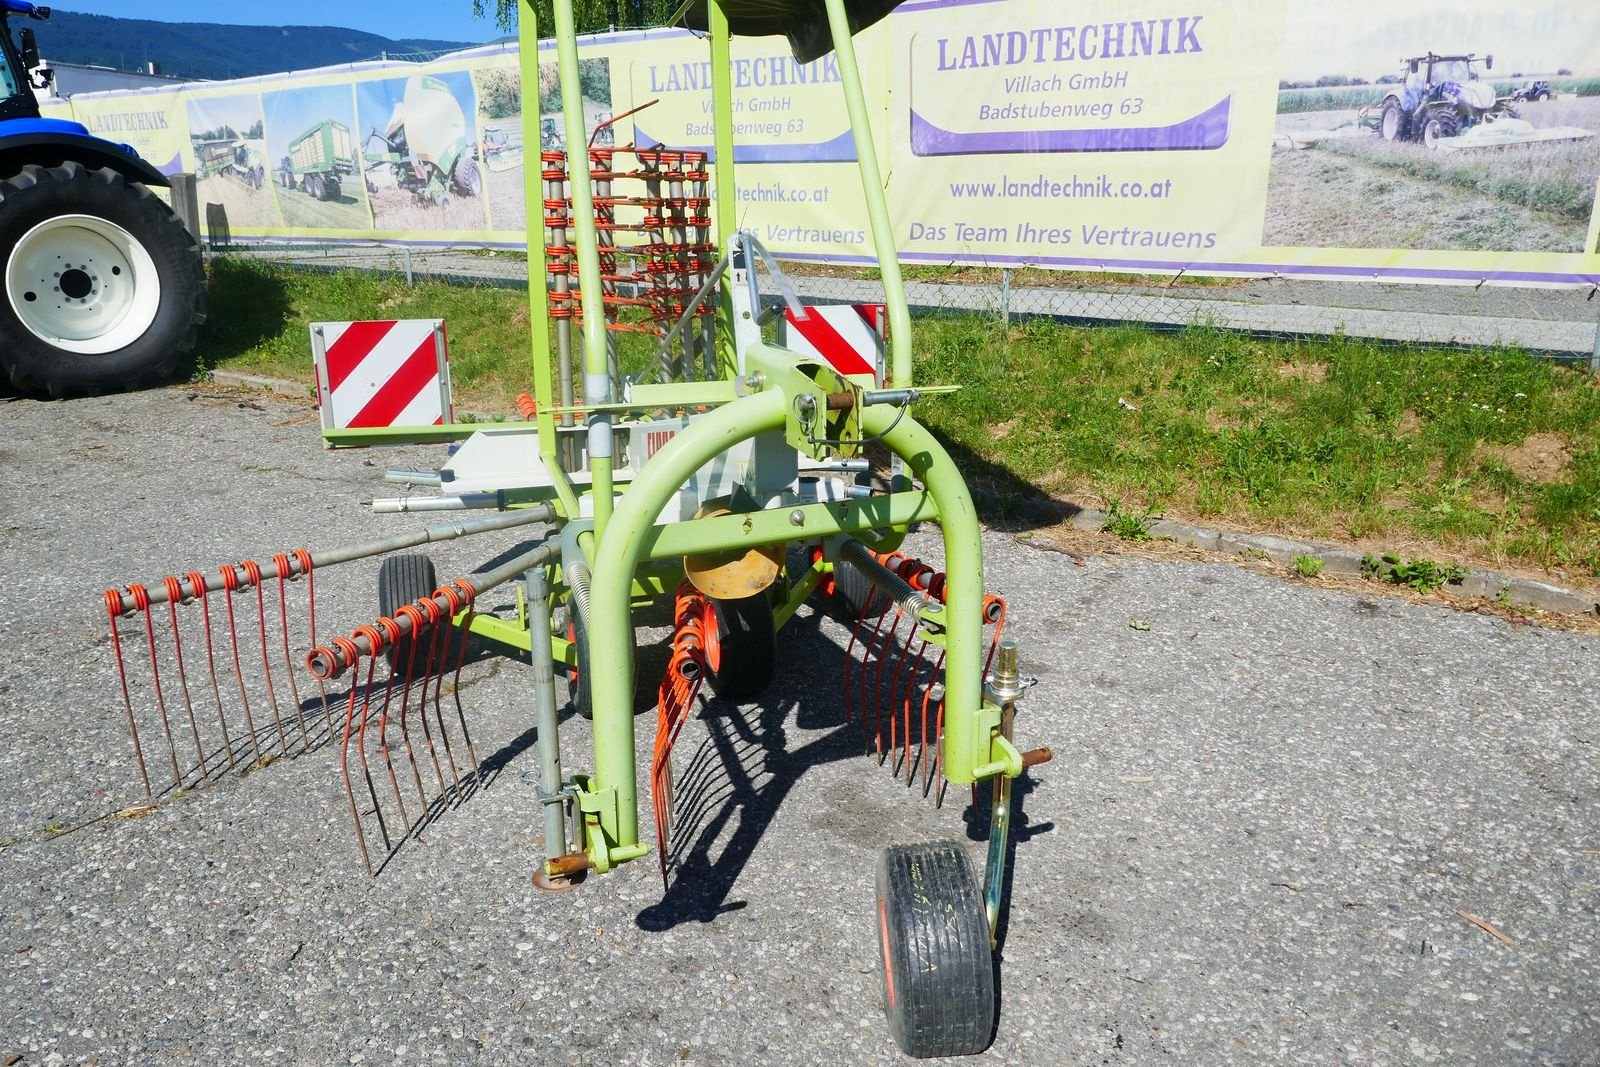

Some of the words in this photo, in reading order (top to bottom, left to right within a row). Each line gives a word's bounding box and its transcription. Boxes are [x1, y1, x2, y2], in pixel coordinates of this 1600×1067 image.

[937, 16, 1203, 71] LANDTECHNIK
[649, 53, 841, 92] LANDECHNIK
[1004, 76, 1061, 93] Villach
[1068, 71, 1128, 90] GmbH
[748, 97, 791, 112] GmbH
[979, 101, 1112, 120] Badstubenweg
[1120, 98, 1143, 114] 63
[87, 111, 168, 133] LANDTECHNIK
[787, 119, 804, 133] 63
[950, 175, 1172, 198] www.landtechnik.co.at
[767, 224, 865, 244] Vertrauens
[909, 222, 946, 241] Das
[955, 223, 1007, 242] Team
[1016, 223, 1071, 244] Ihres
[1081, 225, 1216, 248] Vertrauens
